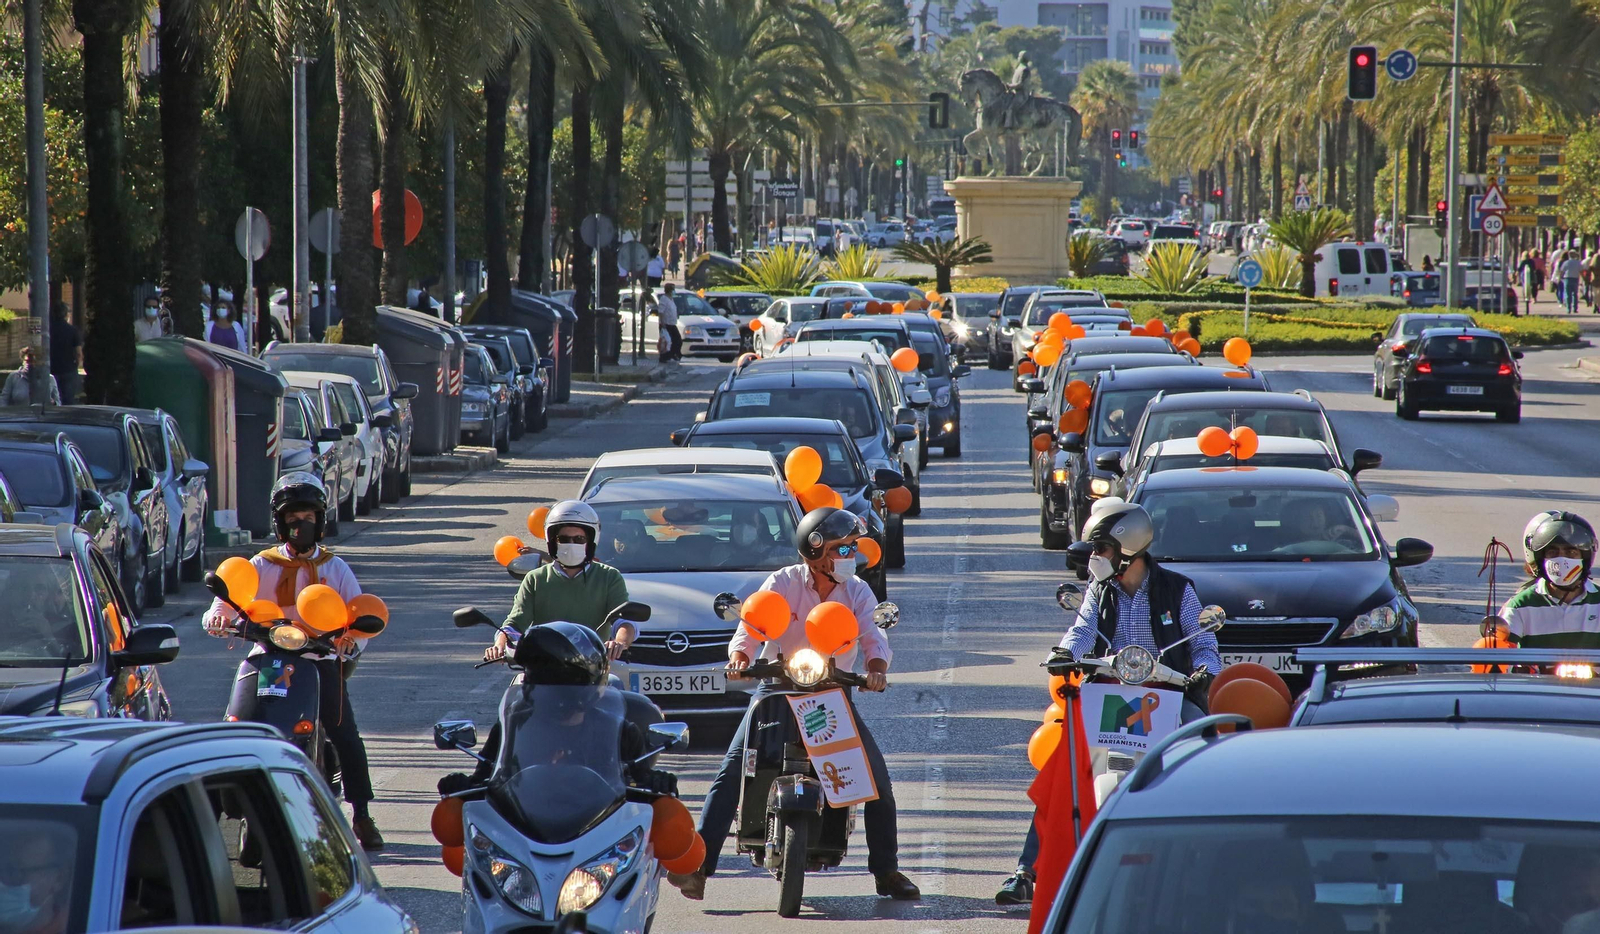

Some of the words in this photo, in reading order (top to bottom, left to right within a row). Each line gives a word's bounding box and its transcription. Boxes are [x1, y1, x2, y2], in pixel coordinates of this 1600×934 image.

[1486, 220, 1501, 229] 30
[642, 676, 684, 691] 3635
[690, 675, 720, 691] KPL
[1097, 739, 1147, 749] MARIANISTAS
